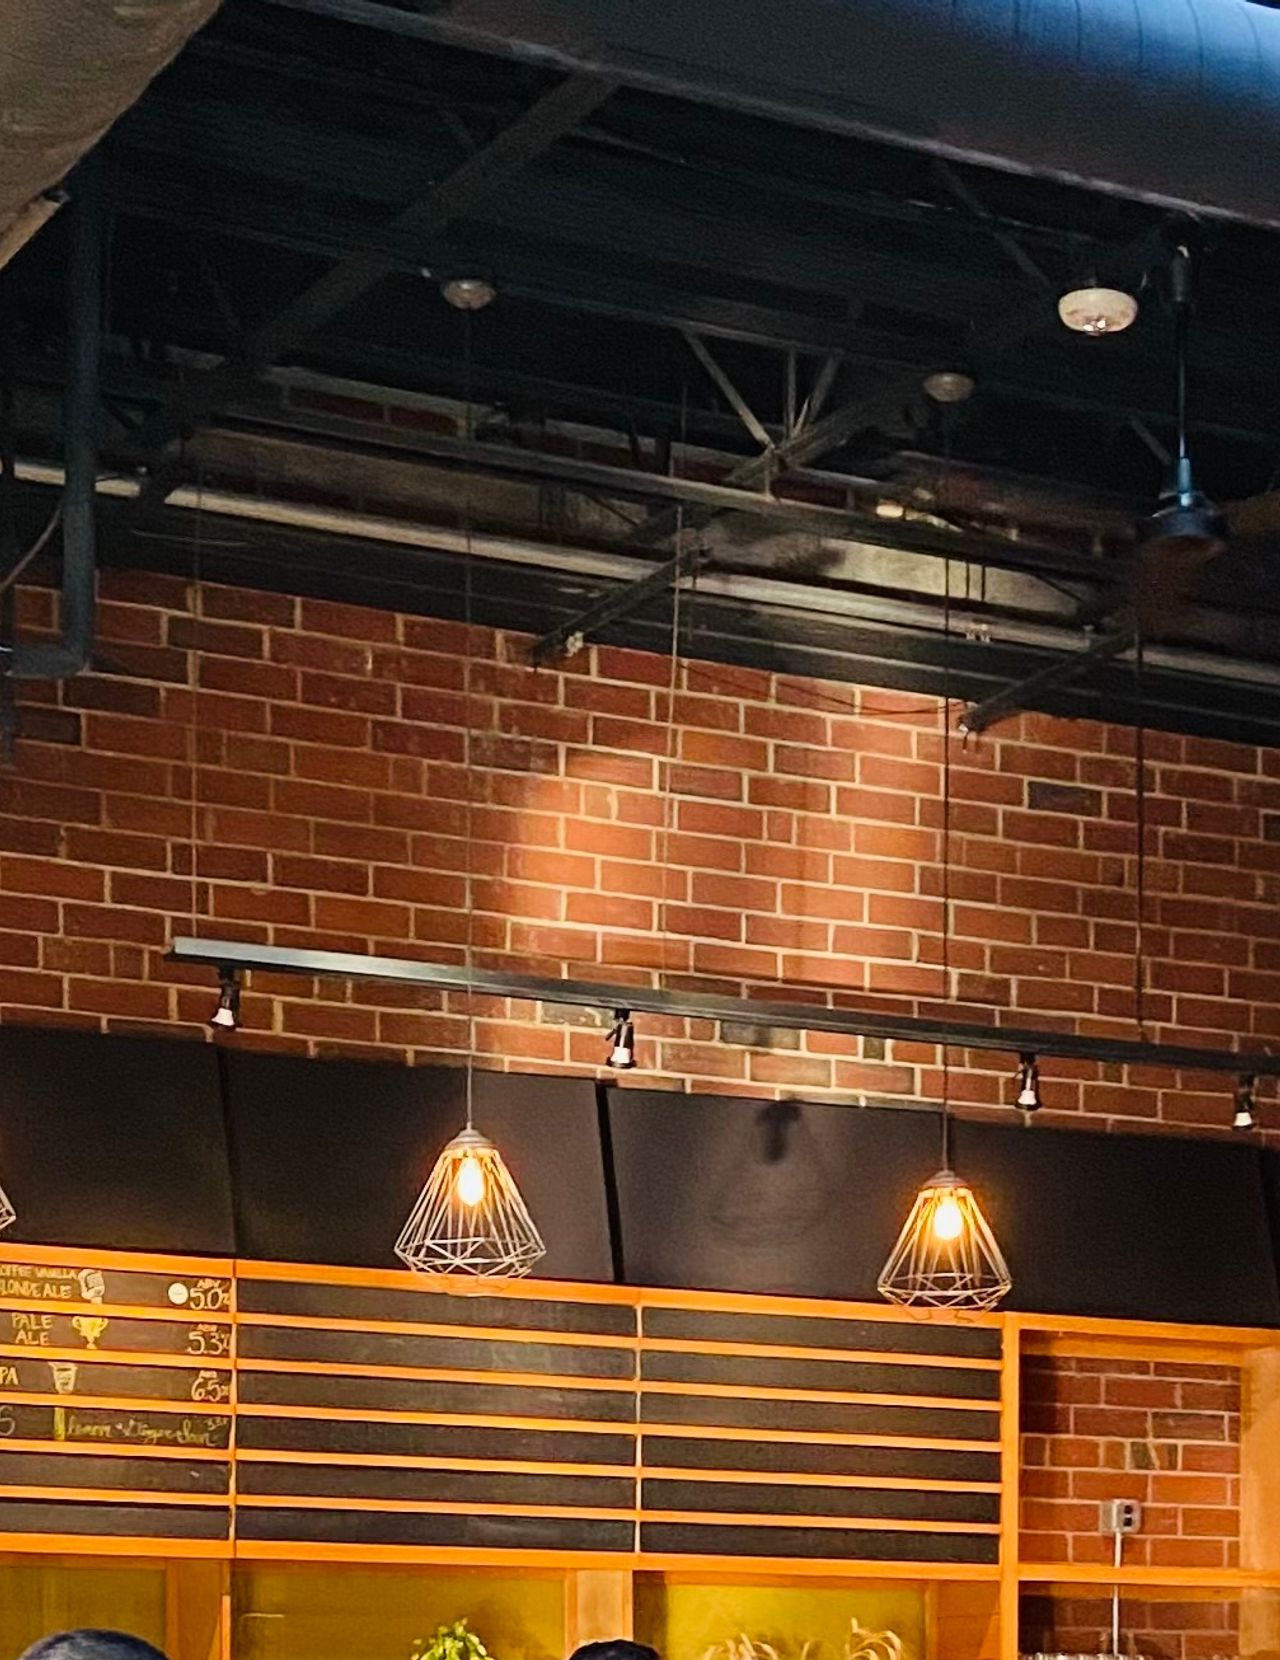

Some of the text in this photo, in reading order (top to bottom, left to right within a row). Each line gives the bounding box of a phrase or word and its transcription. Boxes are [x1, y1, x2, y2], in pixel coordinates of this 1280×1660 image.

[42, 1282, 72, 1299] ALE
[12, 1311, 53, 1330] PALE
[15, 1331, 50, 1346] ALE
